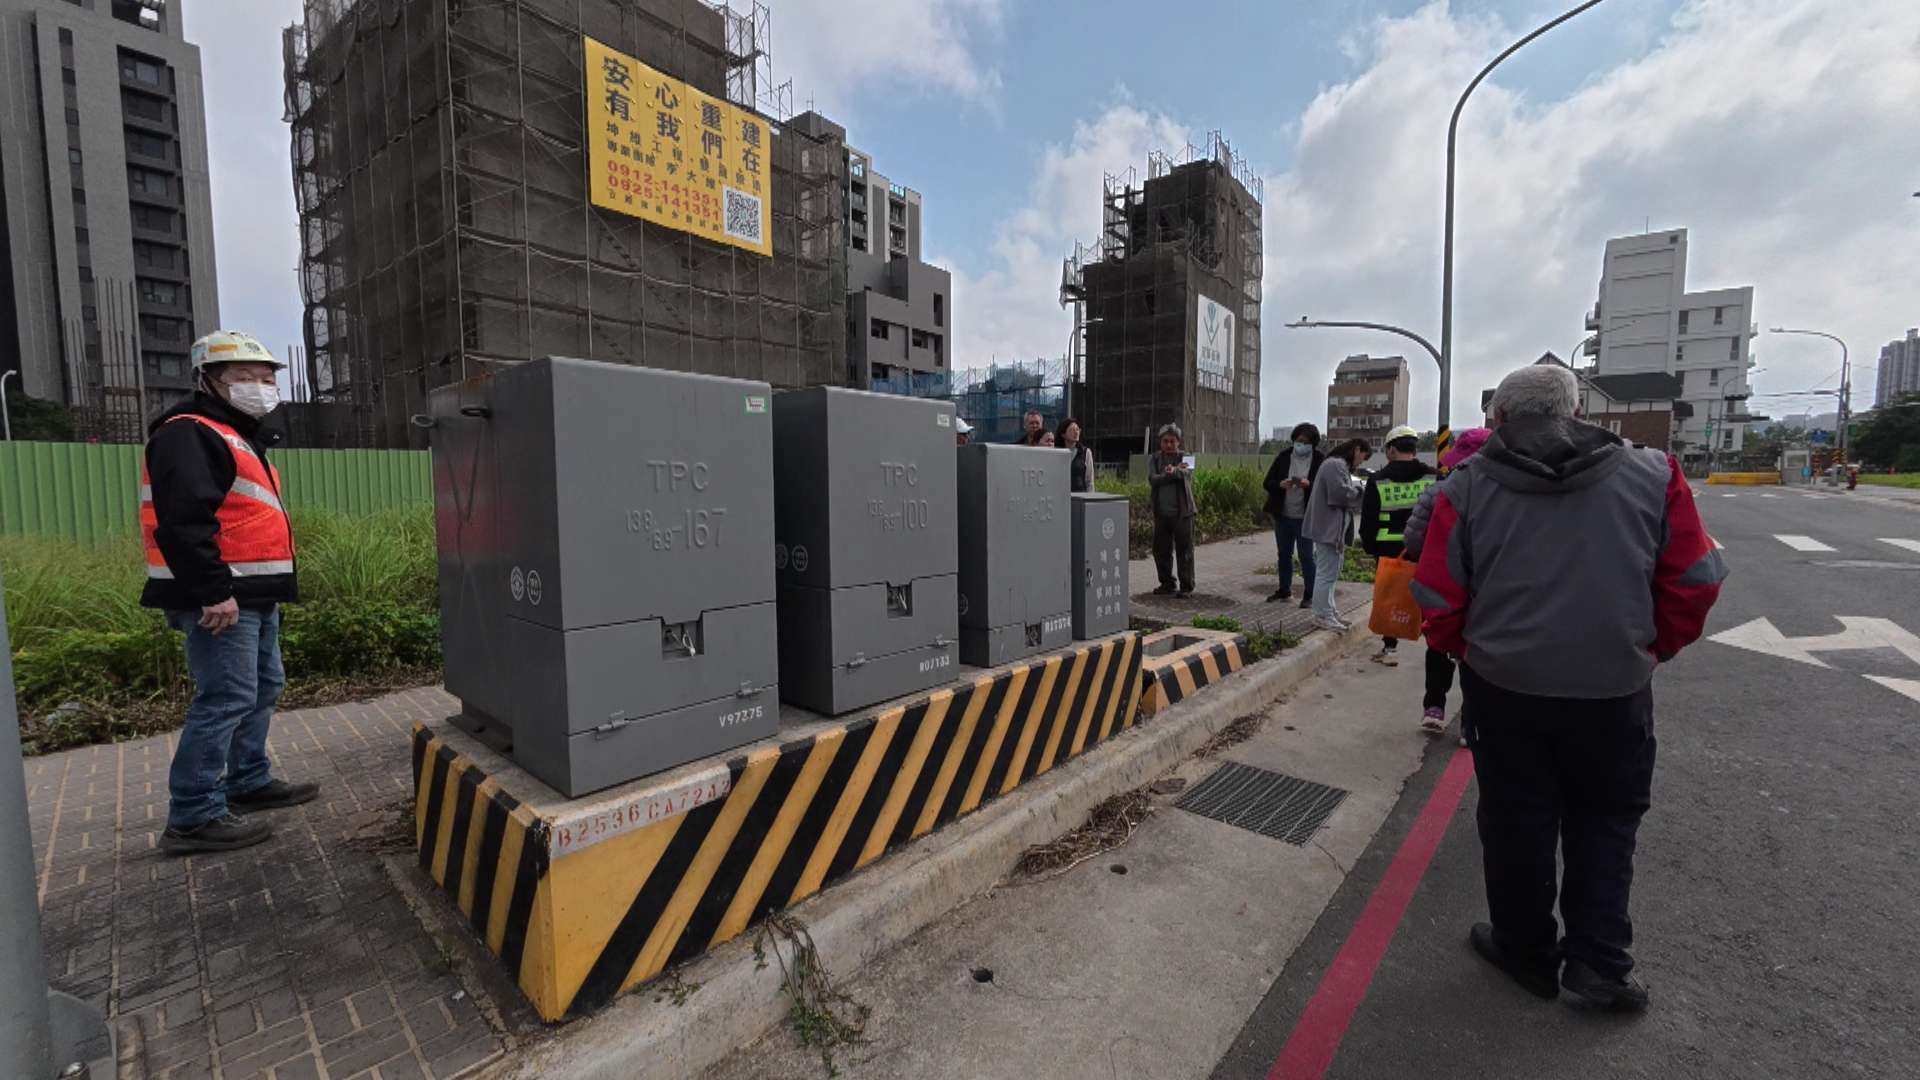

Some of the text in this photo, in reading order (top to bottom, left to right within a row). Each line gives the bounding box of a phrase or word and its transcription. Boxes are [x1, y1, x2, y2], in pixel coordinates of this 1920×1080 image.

[601, 56, 760, 150] 安心重建
[605, 88, 761, 176] 有我們在
[646, 459, 709, 492] TPC
[880, 462, 918, 487] TPC
[1021, 468, 1045, 488] TPC
[719, 705, 763, 728] V97375
